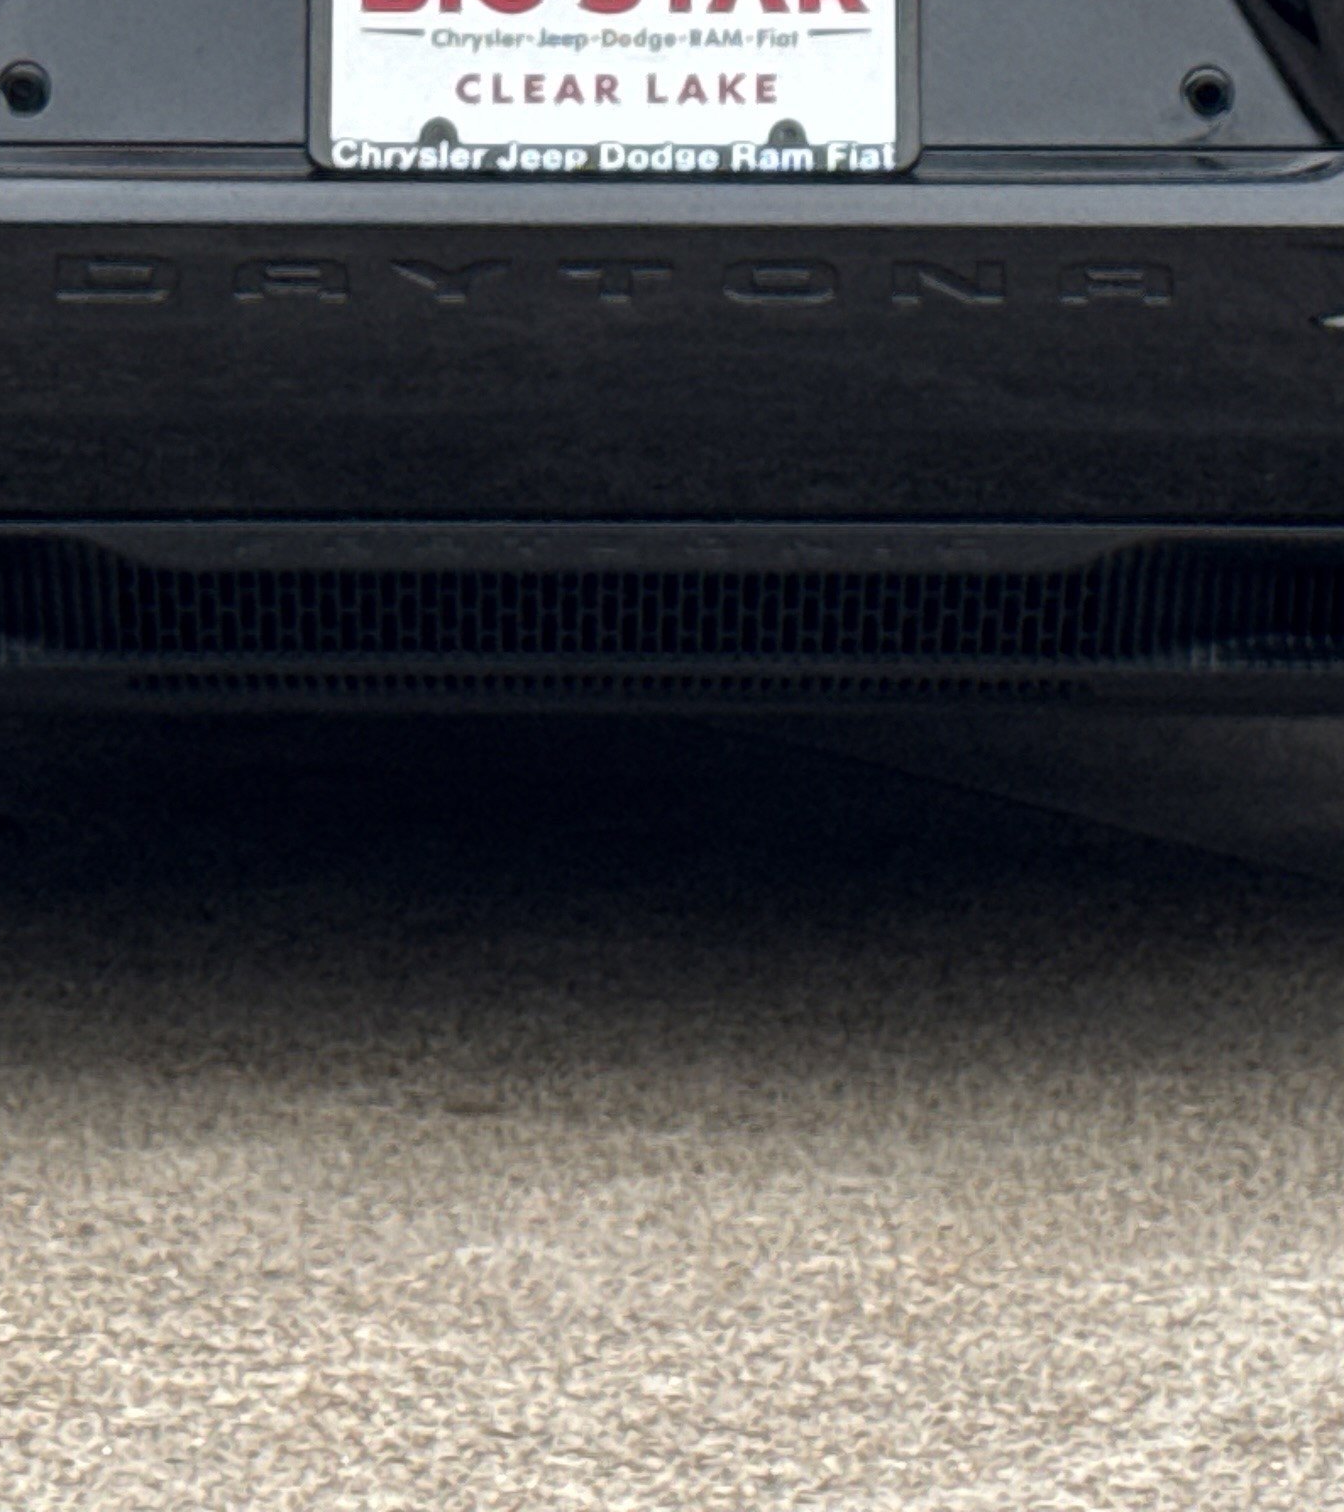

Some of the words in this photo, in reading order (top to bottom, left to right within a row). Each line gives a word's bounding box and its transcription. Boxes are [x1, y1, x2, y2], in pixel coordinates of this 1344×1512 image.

[456, 73, 620, 105] CLEAR
[646, 73, 777, 105] LAKE
[332, 139, 487, 171] Chrysler
[496, 143, 588, 172] Jeep
[600, 142, 719, 171] Dodge
[730, 142, 814, 171] Ram
[826, 142, 896, 171] Fiat
[53, 253, 1174, 304] DAYTONA
